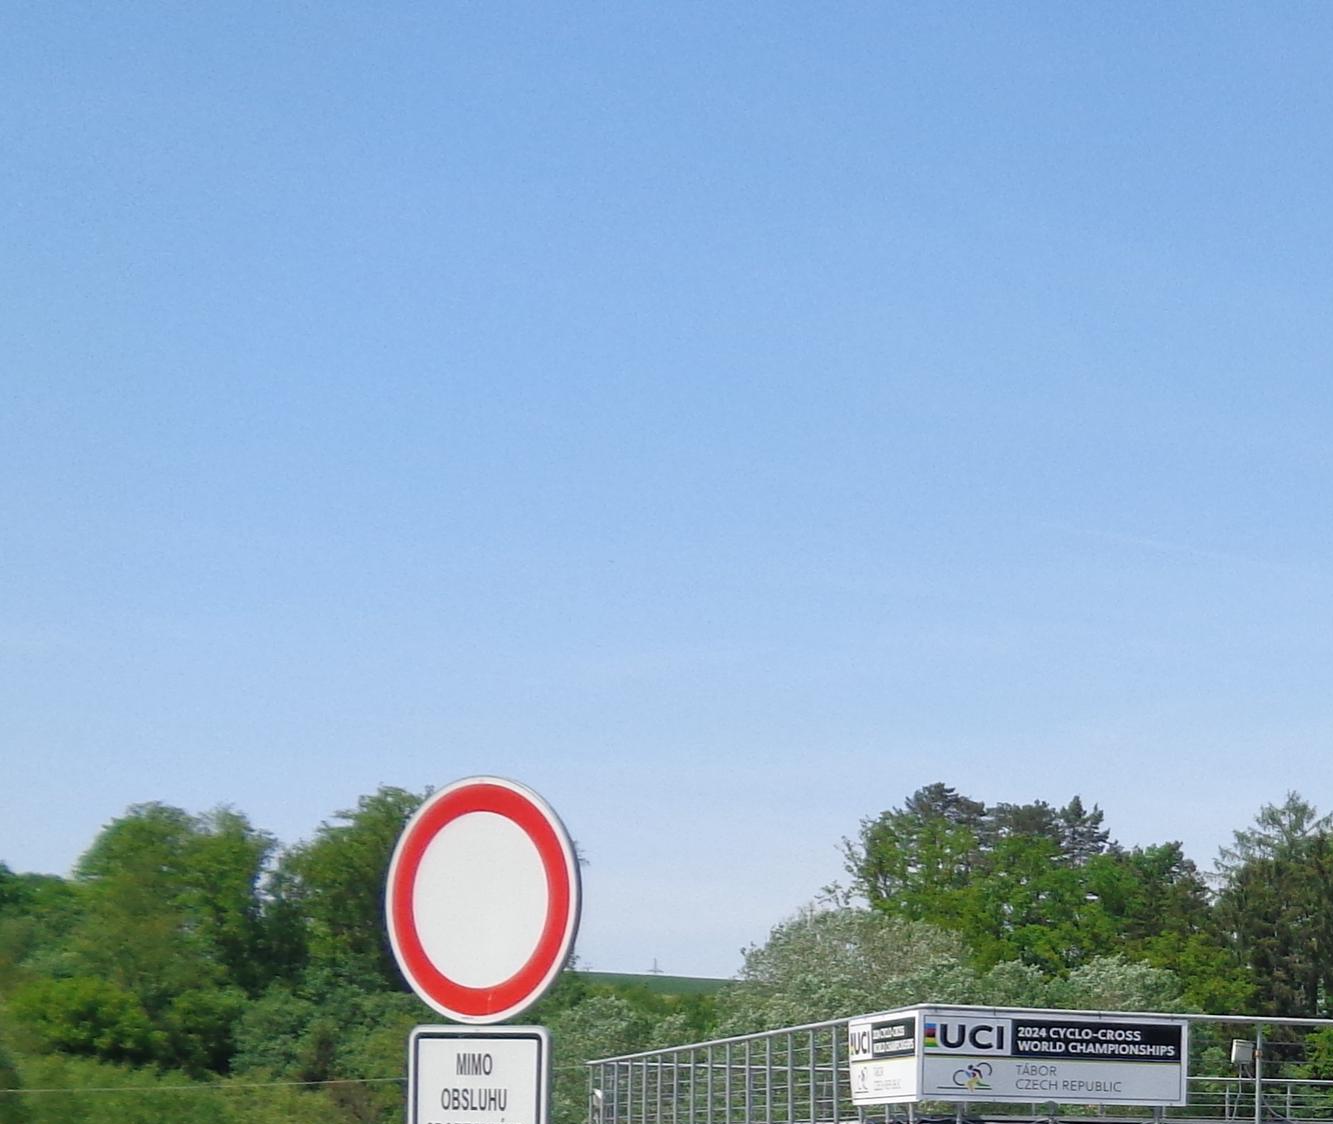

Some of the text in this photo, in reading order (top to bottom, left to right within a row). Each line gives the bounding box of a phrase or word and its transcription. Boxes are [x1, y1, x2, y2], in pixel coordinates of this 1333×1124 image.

[855, 1031, 871, 1055] UCI
[940, 1022, 1004, 1050] UCI
[1017, 1027, 1142, 1042] 2024 CYCLO-CROSS
[1017, 1040, 1176, 1057] WORLD CHAMPIONSHIPS
[456, 1053, 493, 1076] MIMO
[1015, 1063, 1057, 1077] TÁBOR
[1015, 1078, 1122, 1093] CZECH REPUBLIC
[441, 1088, 508, 1111] OBSLUHU
